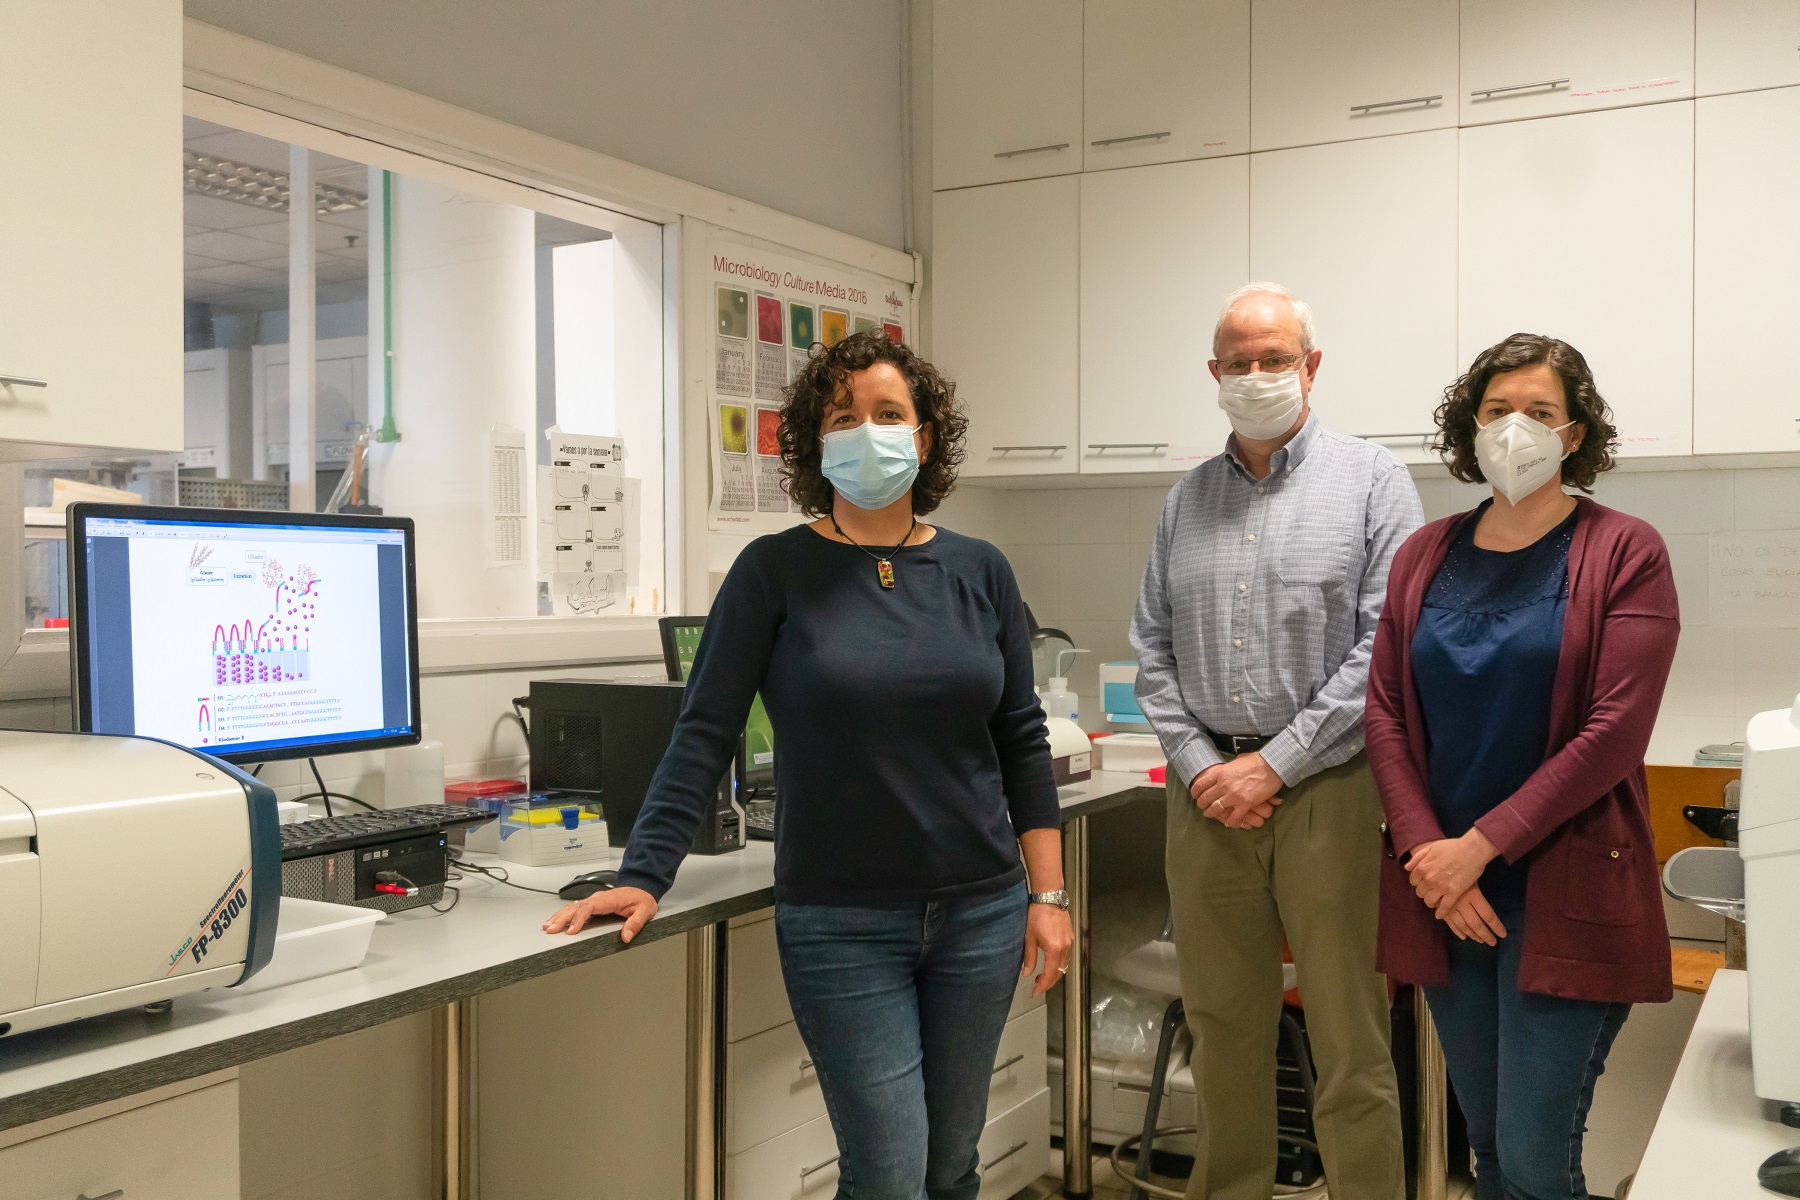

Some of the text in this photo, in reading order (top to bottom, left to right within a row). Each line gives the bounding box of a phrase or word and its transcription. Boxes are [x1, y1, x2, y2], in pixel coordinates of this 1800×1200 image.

[714, 255, 867, 304] Microbiology Culture Media 2016
[721, 347, 744, 359] January
[190, 888, 248, 964] FP-8300
